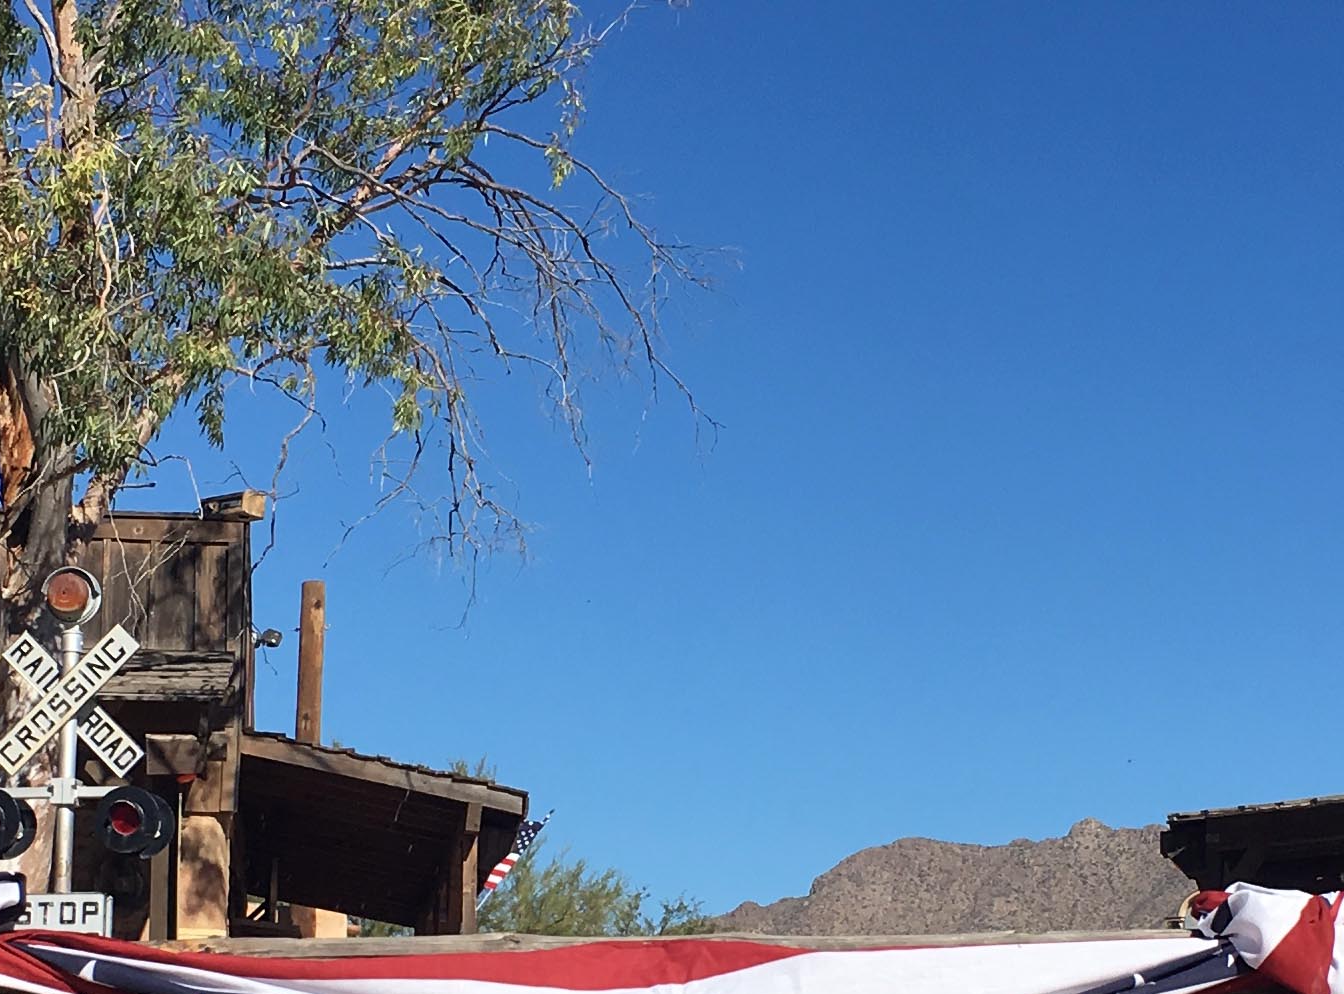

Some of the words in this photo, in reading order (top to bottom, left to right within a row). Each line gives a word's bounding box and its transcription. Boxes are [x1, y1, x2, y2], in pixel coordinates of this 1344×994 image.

[0, 637, 126, 767] CROSSING
[10, 639, 59, 693] RAIL
[79, 711, 137, 770] ROAD
[17, 901, 99, 925] STOP
